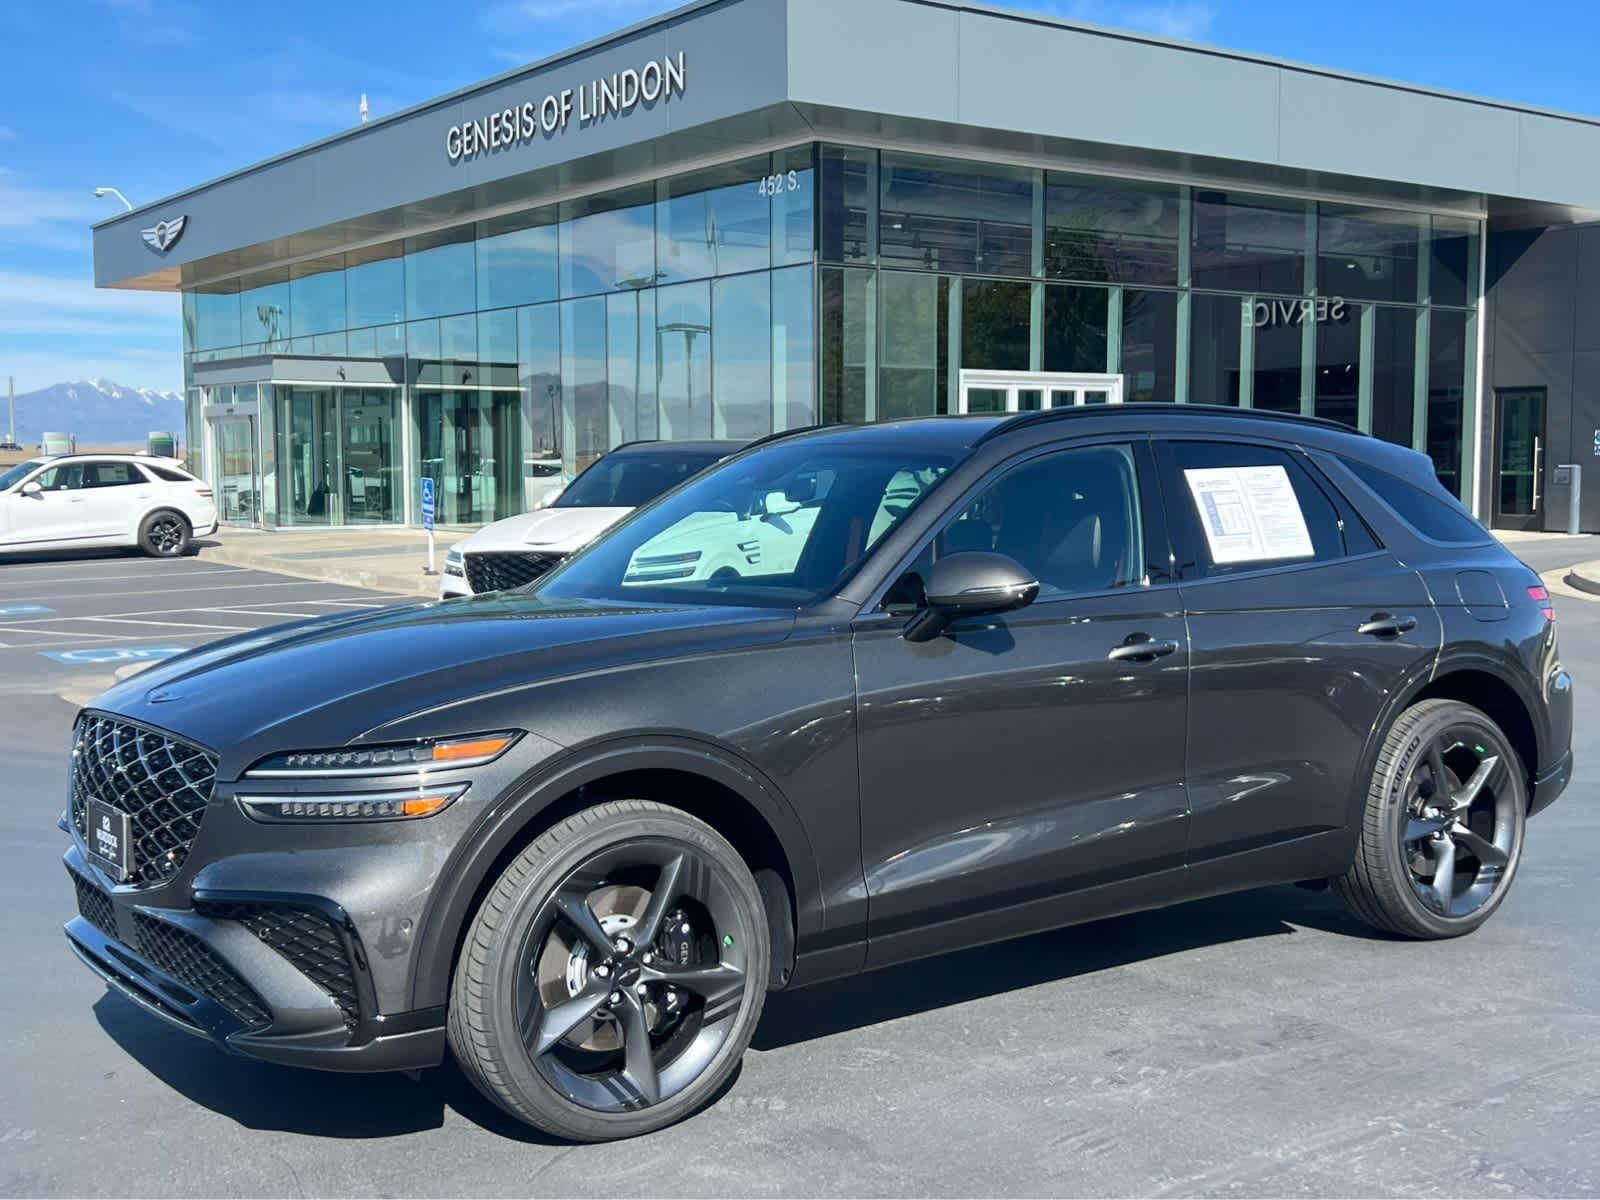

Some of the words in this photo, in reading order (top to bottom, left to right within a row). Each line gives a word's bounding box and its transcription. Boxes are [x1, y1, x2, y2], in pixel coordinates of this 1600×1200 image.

[447, 102, 535, 159] GENESIS
[541, 88, 572, 131] OF
[580, 50, 684, 121] LINDON
[759, 174, 783, 198] 452
[787, 170, 801, 192] S.
